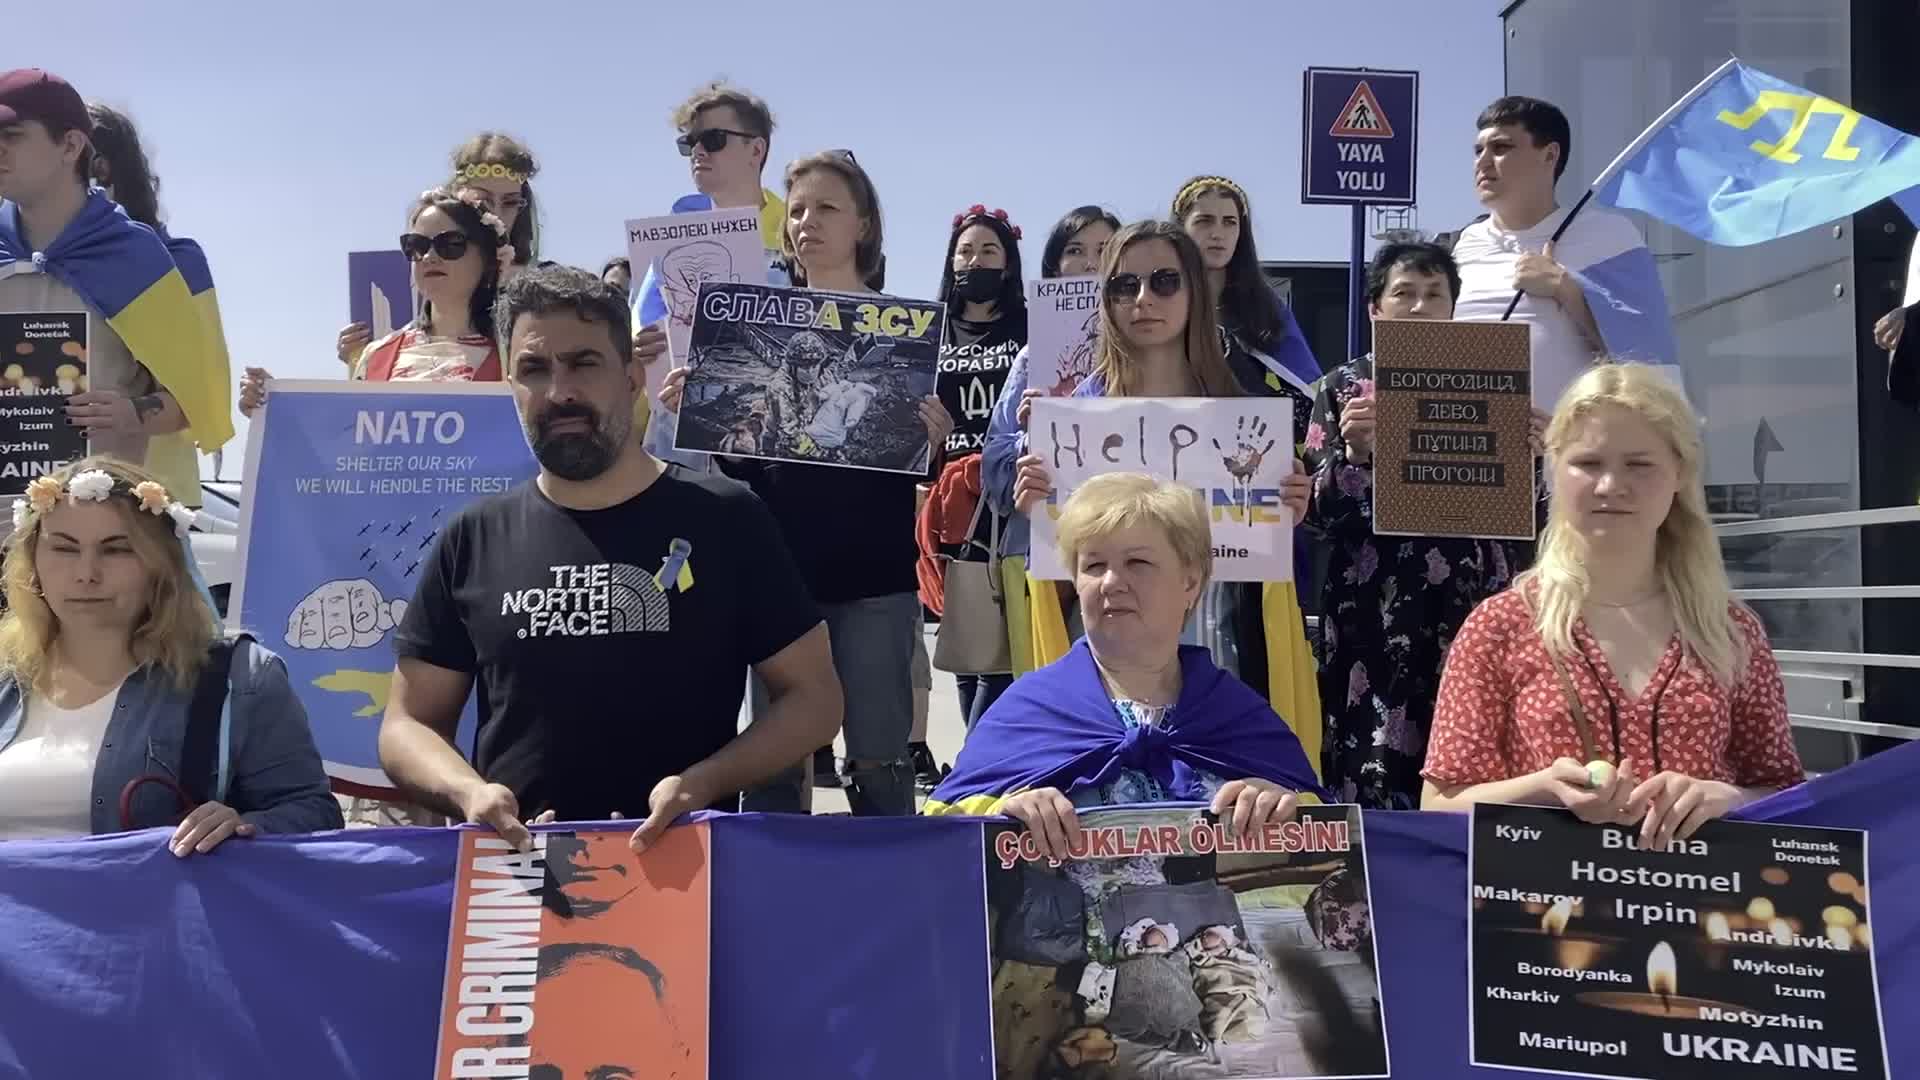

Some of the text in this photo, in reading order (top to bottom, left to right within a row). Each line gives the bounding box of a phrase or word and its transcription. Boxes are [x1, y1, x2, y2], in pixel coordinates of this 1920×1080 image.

[1337, 143, 1384, 163] YAYA
[1336, 171, 1385, 191] YOLU
[630, 217, 758, 243] МАВЗОЛЕЮ НУЖЕН
[1056, 297, 1074, 311] НЕ
[703, 292, 937, 338] СЛАВА ЗСУ
[1391, 372, 1517, 393] БОГОРОДИЦА,
[19, 422, 54, 431] Izum
[355, 410, 465, 445] NATO
[1050, 415, 1199, 480] Help
[1417, 434, 1487, 452] ПУТИНА
[336, 455, 477, 473] SHELTER OUR SKY
[1409, 465, 1496, 482] ПРОГОНИ
[296, 477, 513, 494] WE WILL HENDLE THE REST
[550, 564, 610, 588] THE
[501, 586, 609, 616] NORTH
[530, 610, 609, 637] FACE
[1496, 825, 1542, 842] Kyiv
[995, 826, 1184, 869] ÇOUKLAR
[1772, 838, 1840, 852] Luhansk
[1775, 852, 1841, 865] Donetsk
[1571, 860, 1741, 893] Hostomel
[1473, 885, 1584, 906] Makarov
[1616, 898, 1697, 925] Irpin
[1517, 962, 1632, 983] Borodyanka
[1732, 958, 1825, 977] Mykolaiv
[1486, 986, 1560, 1004] Kharkiv
[1774, 984, 1826, 1000] Izum
[1700, 1007, 1824, 1030] Motyzhin
[1519, 1031, 1628, 1056] Mariupol
[1662, 1032, 1858, 1072] UKRAINE
